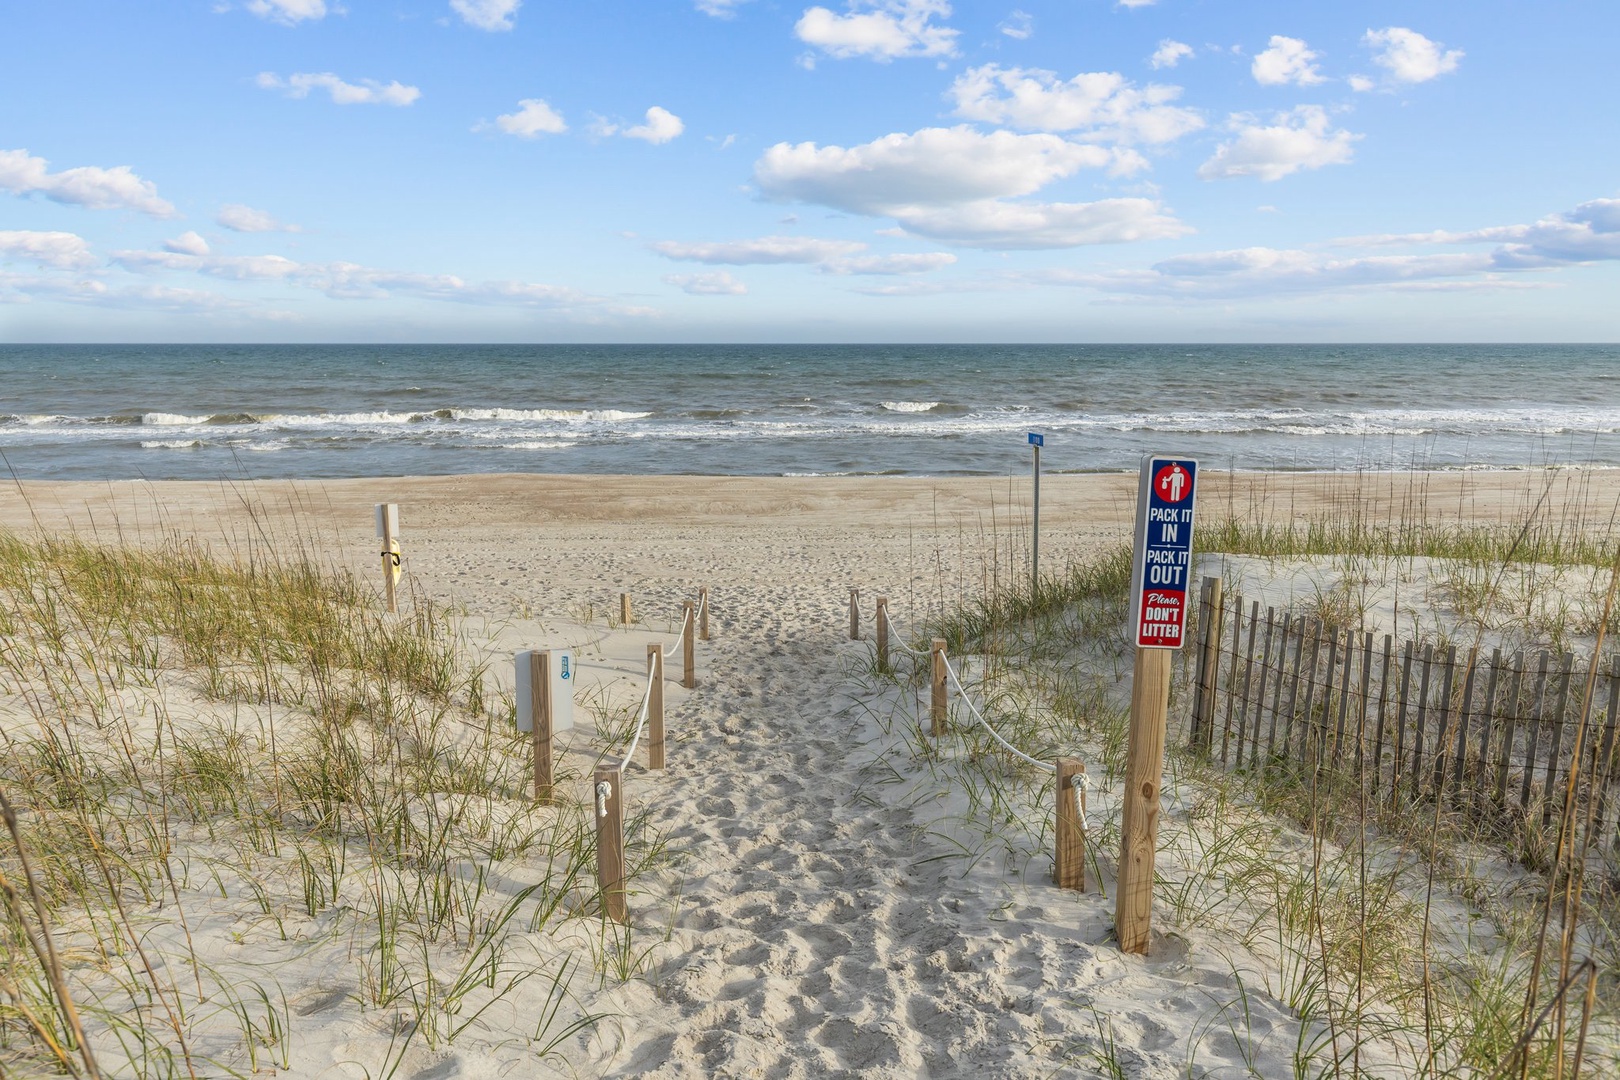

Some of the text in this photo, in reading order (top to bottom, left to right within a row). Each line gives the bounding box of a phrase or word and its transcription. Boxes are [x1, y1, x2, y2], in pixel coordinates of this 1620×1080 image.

[1150, 507, 1192, 523] PACK IT
[1161, 523, 1178, 543] IN
[1147, 549, 1189, 565] PACK IT
[1150, 565, 1183, 585] OUT
[1147, 593, 1180, 606] Please,
[1145, 606, 1180, 622] DON'T
[1142, 623, 1180, 638] LITTER
